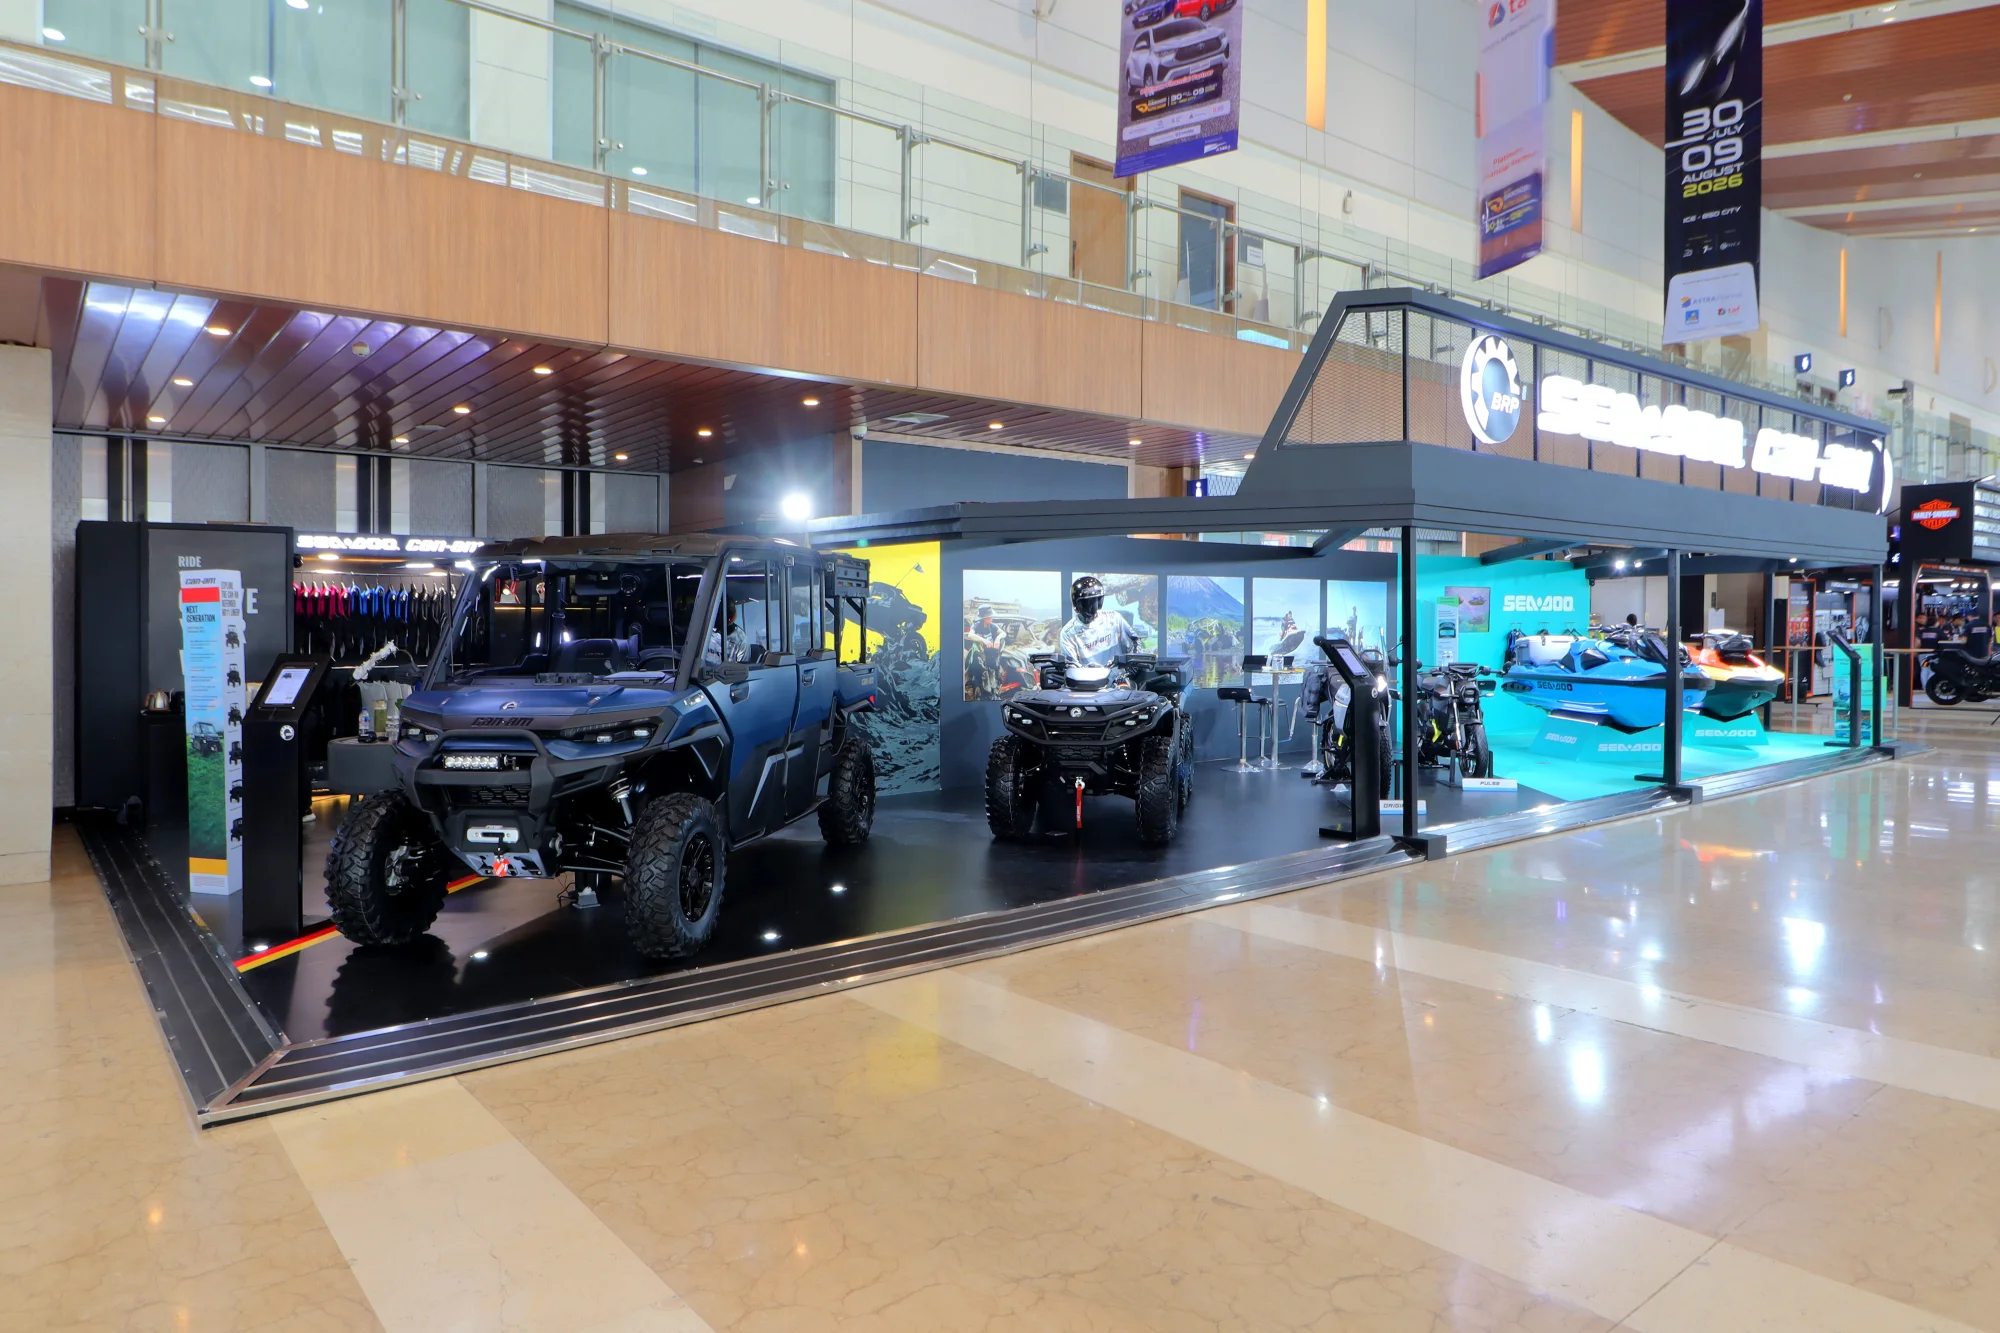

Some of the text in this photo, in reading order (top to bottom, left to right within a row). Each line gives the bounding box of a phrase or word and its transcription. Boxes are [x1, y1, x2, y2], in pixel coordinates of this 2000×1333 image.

[1682, 99, 1744, 137] 30
[1706, 122, 1745, 141] JULY
[1681, 137, 1743, 173] 09
[1681, 161, 1745, 185] AUGUST
[1682, 173, 1743, 198] 2026
[1682, 214, 1696, 224] ICE
[1721, 205, 1742, 217] CITY
[1491, 391, 1520, 415] BRP
[1913, 509, 1958, 519] HARLEY-DAVIDSON
[178, 556, 202, 568] RIDE
[186, 606, 198, 614] NEXT
[186, 614, 216, 623] GENERATION
